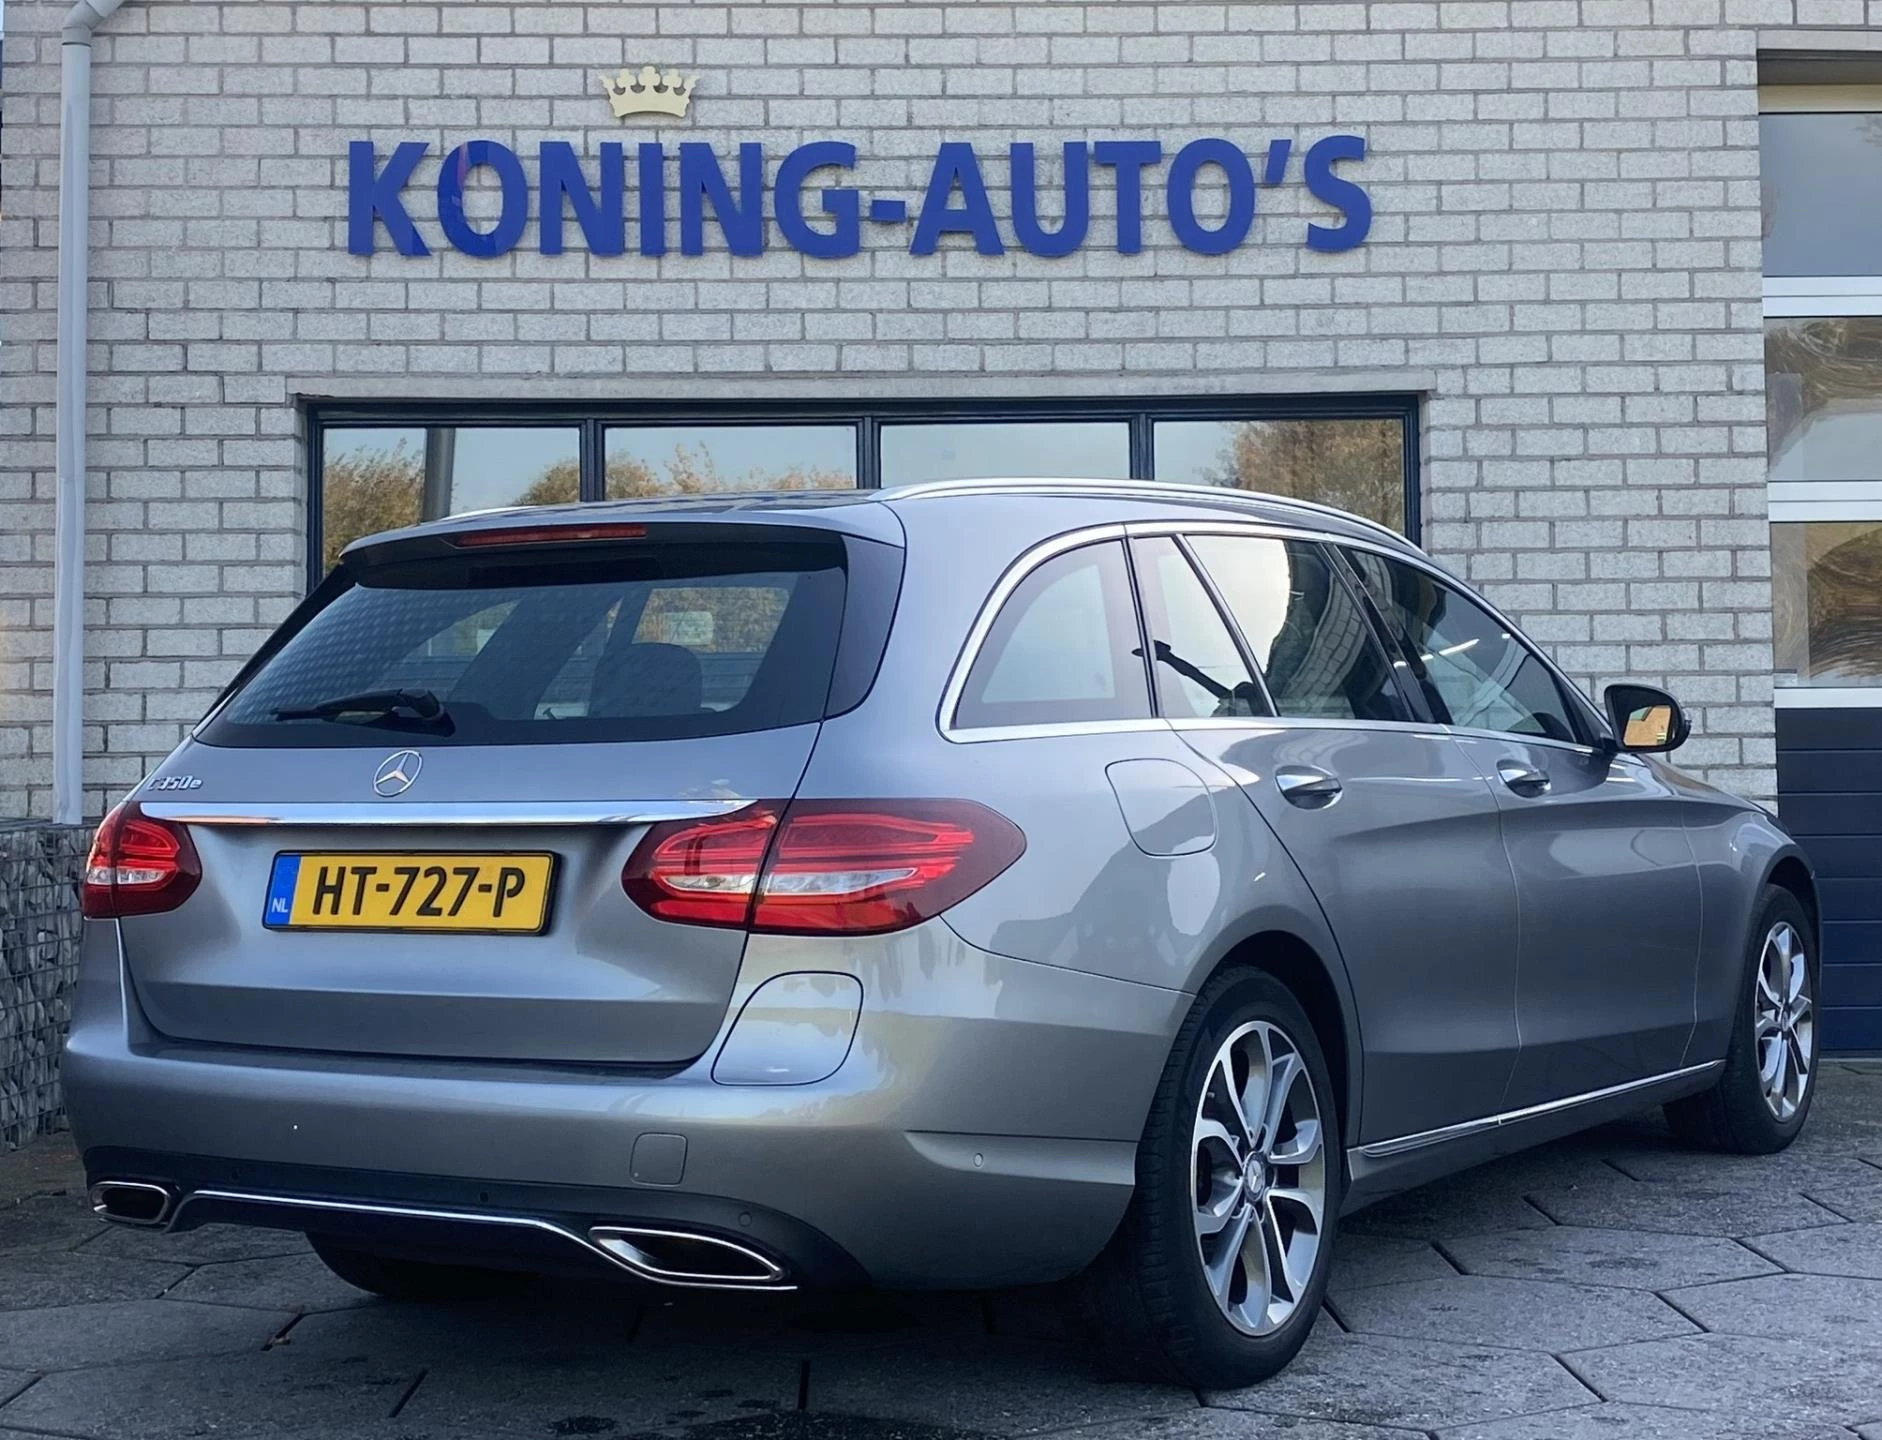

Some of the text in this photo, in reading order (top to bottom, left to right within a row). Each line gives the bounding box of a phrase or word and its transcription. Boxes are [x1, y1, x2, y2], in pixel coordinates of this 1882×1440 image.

[348, 135, 1373, 259] KONING-AUTO'S
[271, 897, 289, 913] NL
[312, 866, 526, 918] HT-727-P
